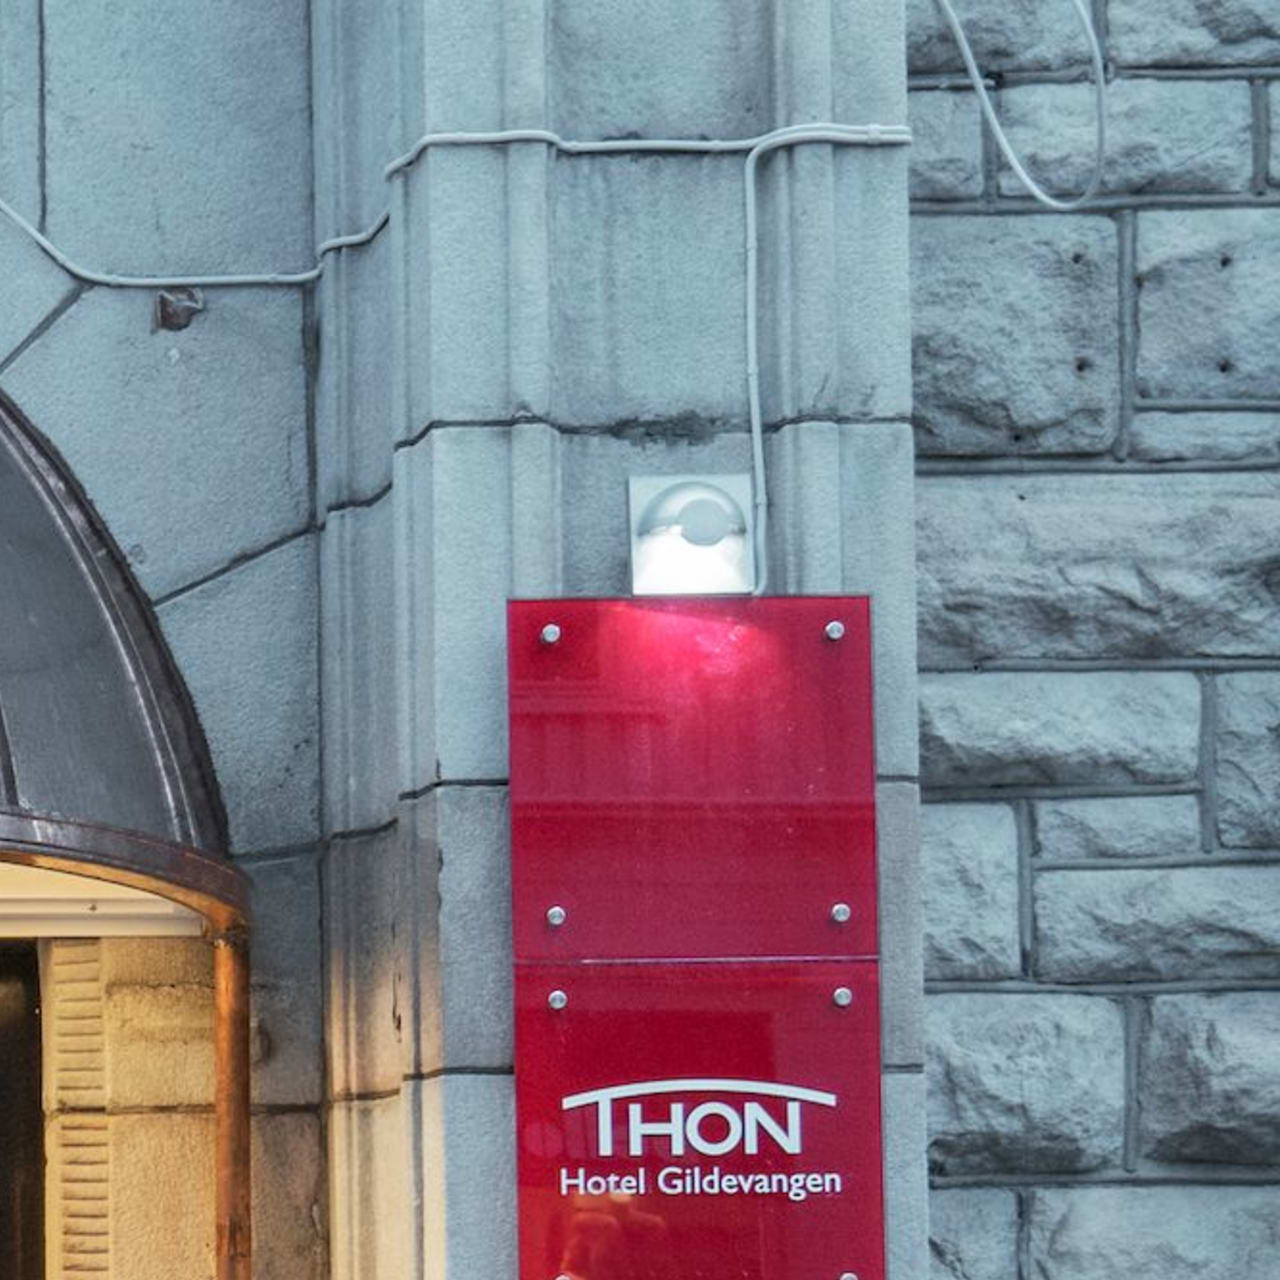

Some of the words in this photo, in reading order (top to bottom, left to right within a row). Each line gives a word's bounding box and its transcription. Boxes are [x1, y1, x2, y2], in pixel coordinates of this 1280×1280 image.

[561, 1078, 837, 1157] THON
[560, 1167, 646, 1196] Hotel
[657, 1166, 842, 1201] Gildevangen
